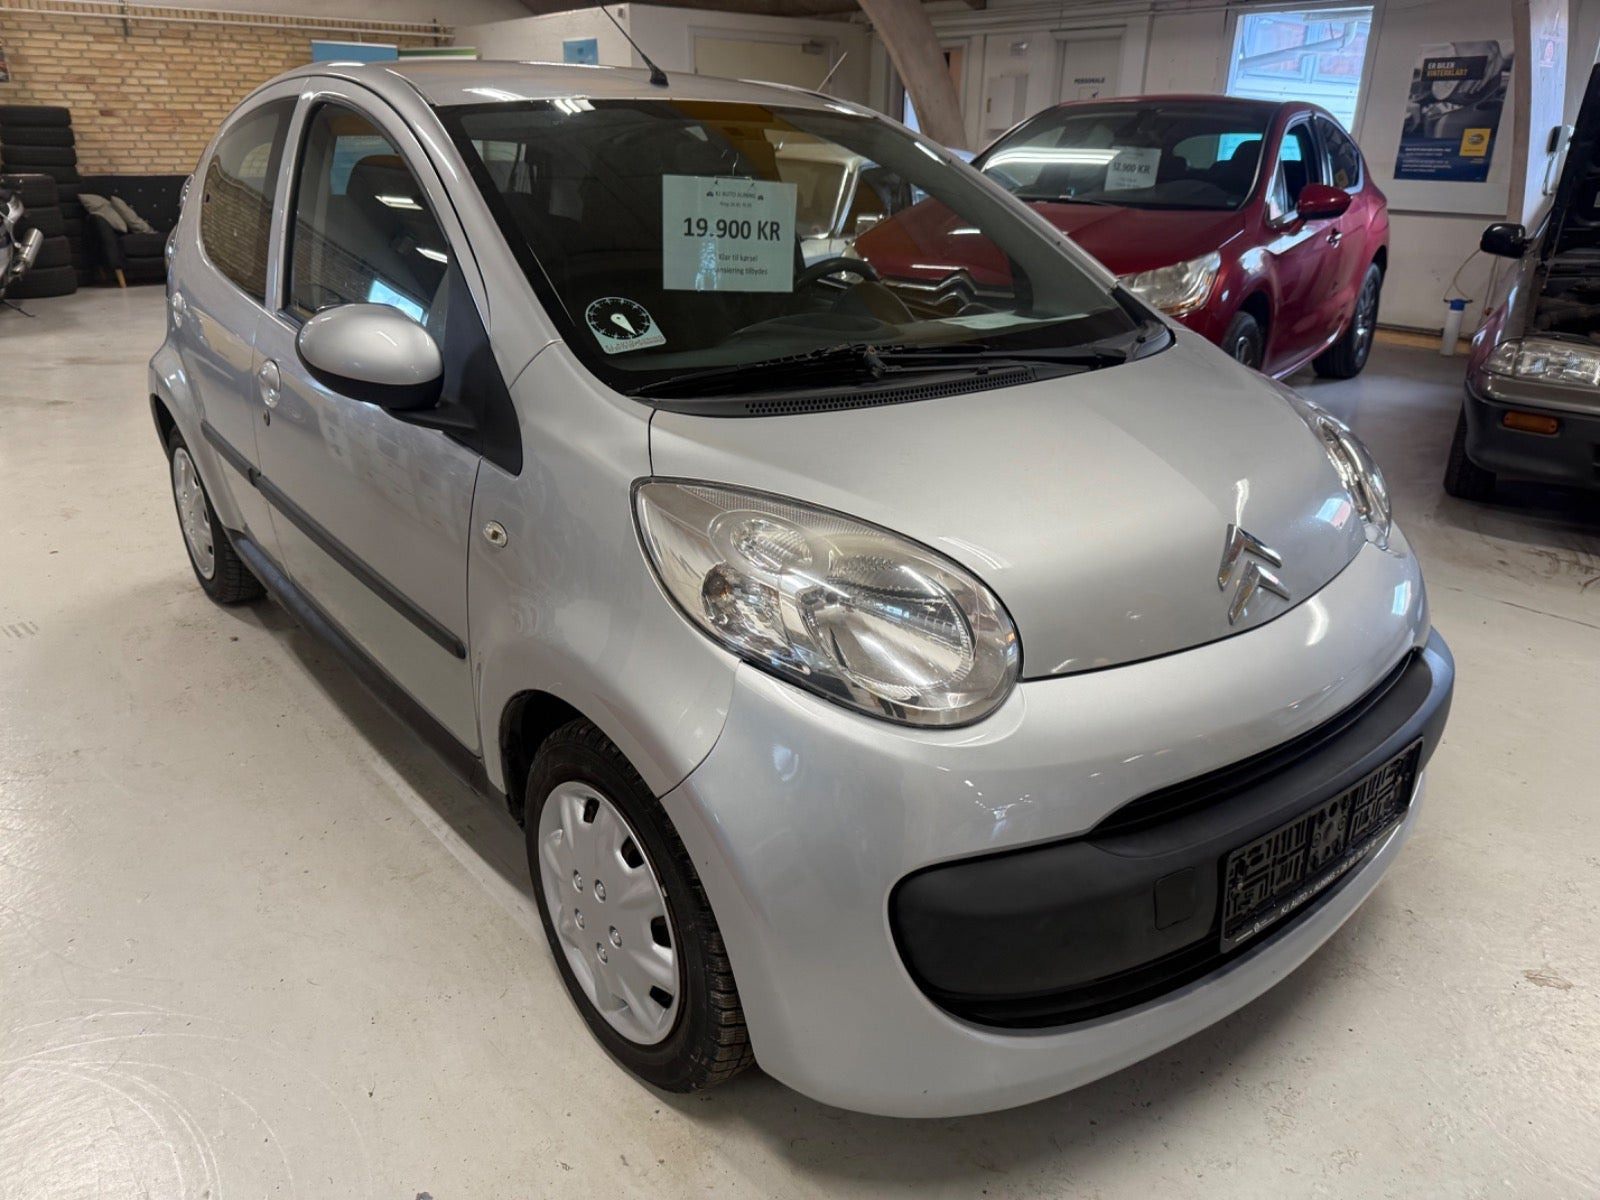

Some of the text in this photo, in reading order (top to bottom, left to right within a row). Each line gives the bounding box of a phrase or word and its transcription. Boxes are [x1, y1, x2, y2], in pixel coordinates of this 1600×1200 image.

[1137, 164, 1150, 175] KR
[683, 217, 781, 241] 19.900 KR
[718, 253, 731, 262] Klar
[1290, 892, 1308, 908] AUTO
